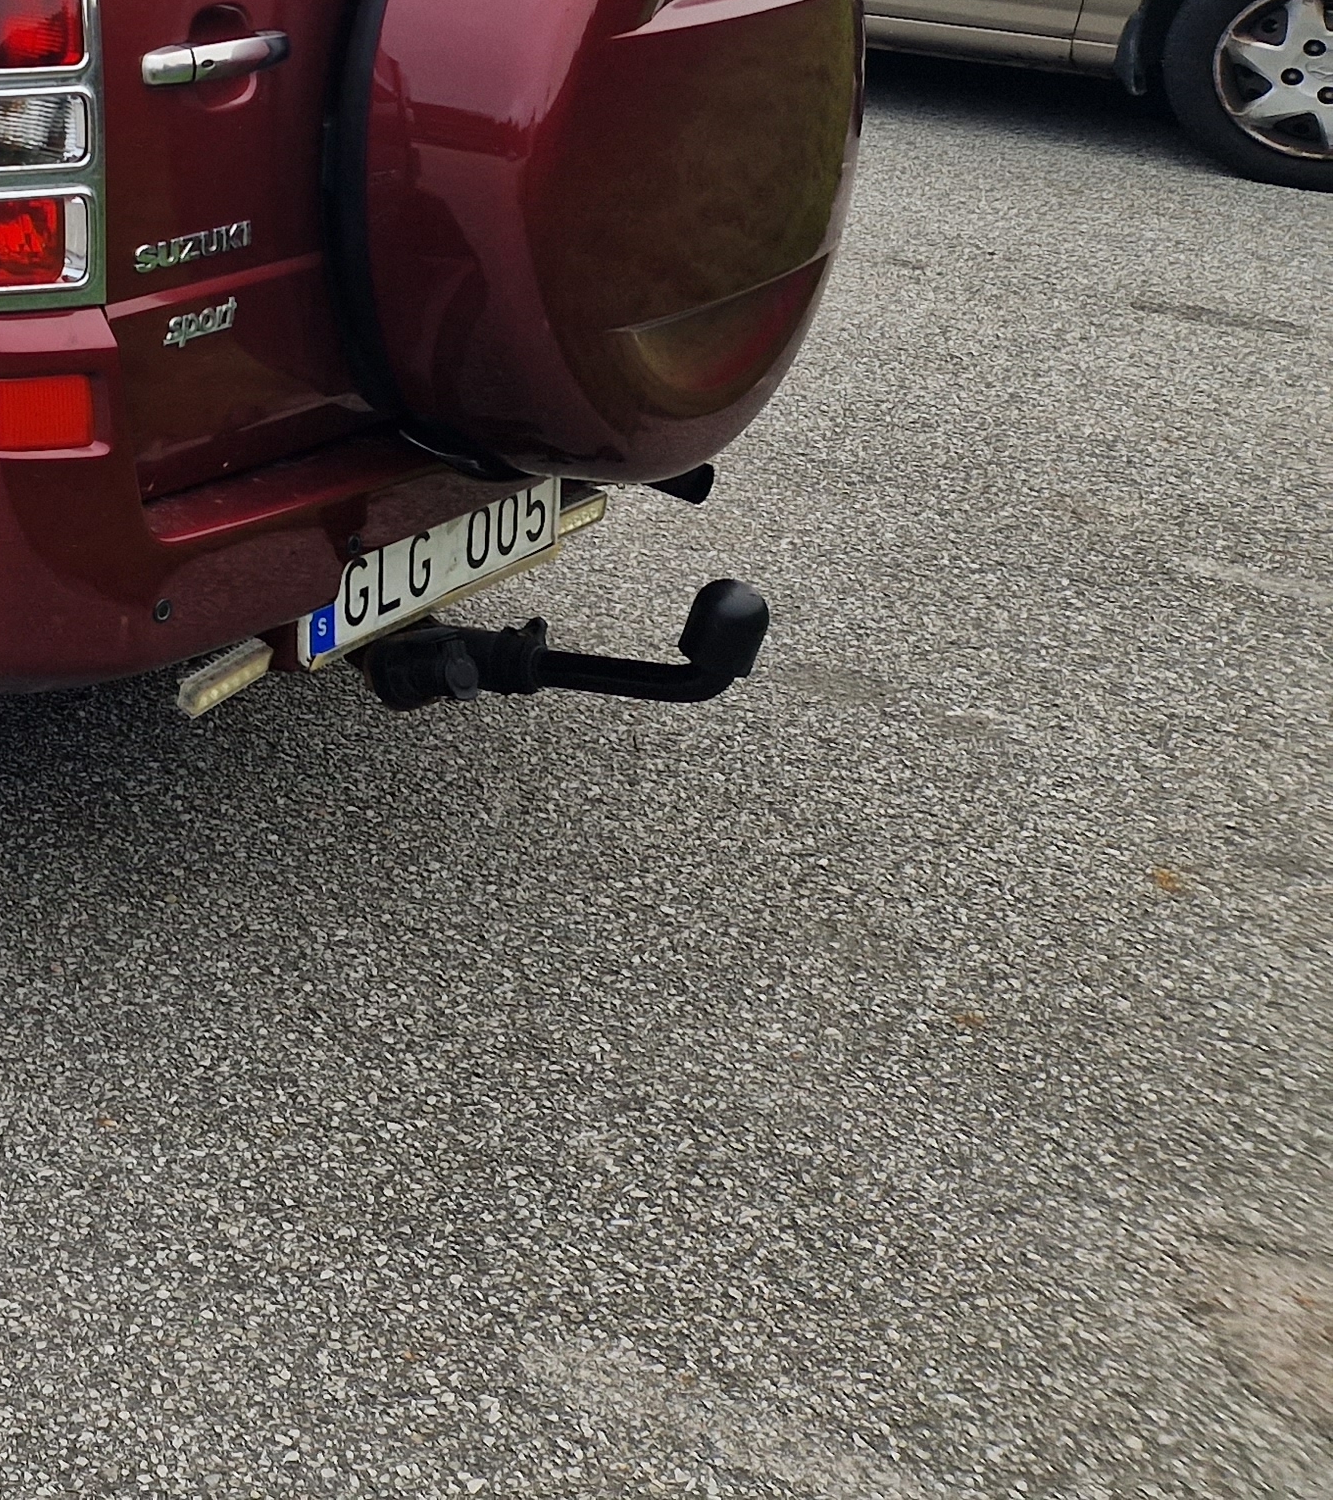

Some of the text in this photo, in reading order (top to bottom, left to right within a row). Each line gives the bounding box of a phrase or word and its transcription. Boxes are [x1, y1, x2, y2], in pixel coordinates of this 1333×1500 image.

[134, 220, 252, 273] SUZUKI
[163, 296, 237, 347] sport
[344, 487, 546, 627] GLG 005
[317, 616, 327, 637] S
